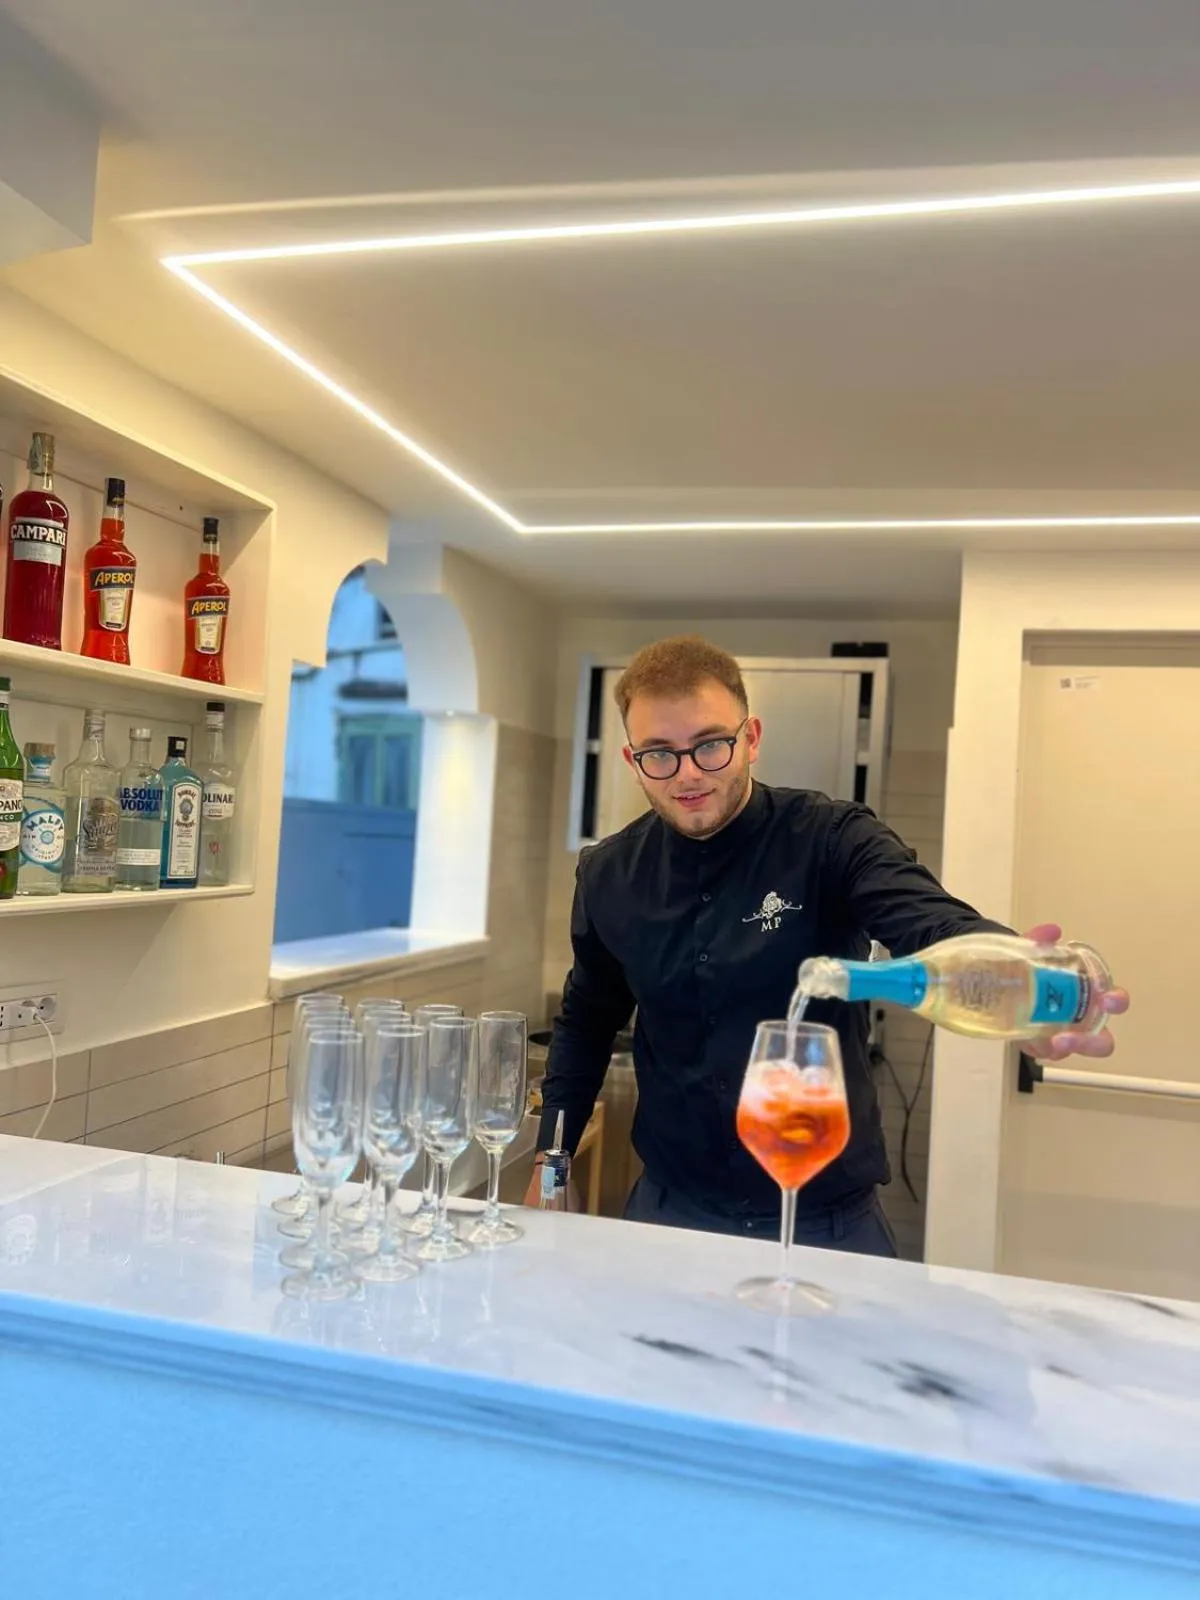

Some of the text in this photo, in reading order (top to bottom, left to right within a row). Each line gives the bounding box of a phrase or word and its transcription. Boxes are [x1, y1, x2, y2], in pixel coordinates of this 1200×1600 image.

[10, 524, 66, 546] CAMPARI
[94, 571, 135, 587] APEROL
[191, 600, 227, 615] APEROL
[120, 799, 160, 812] VODKA
